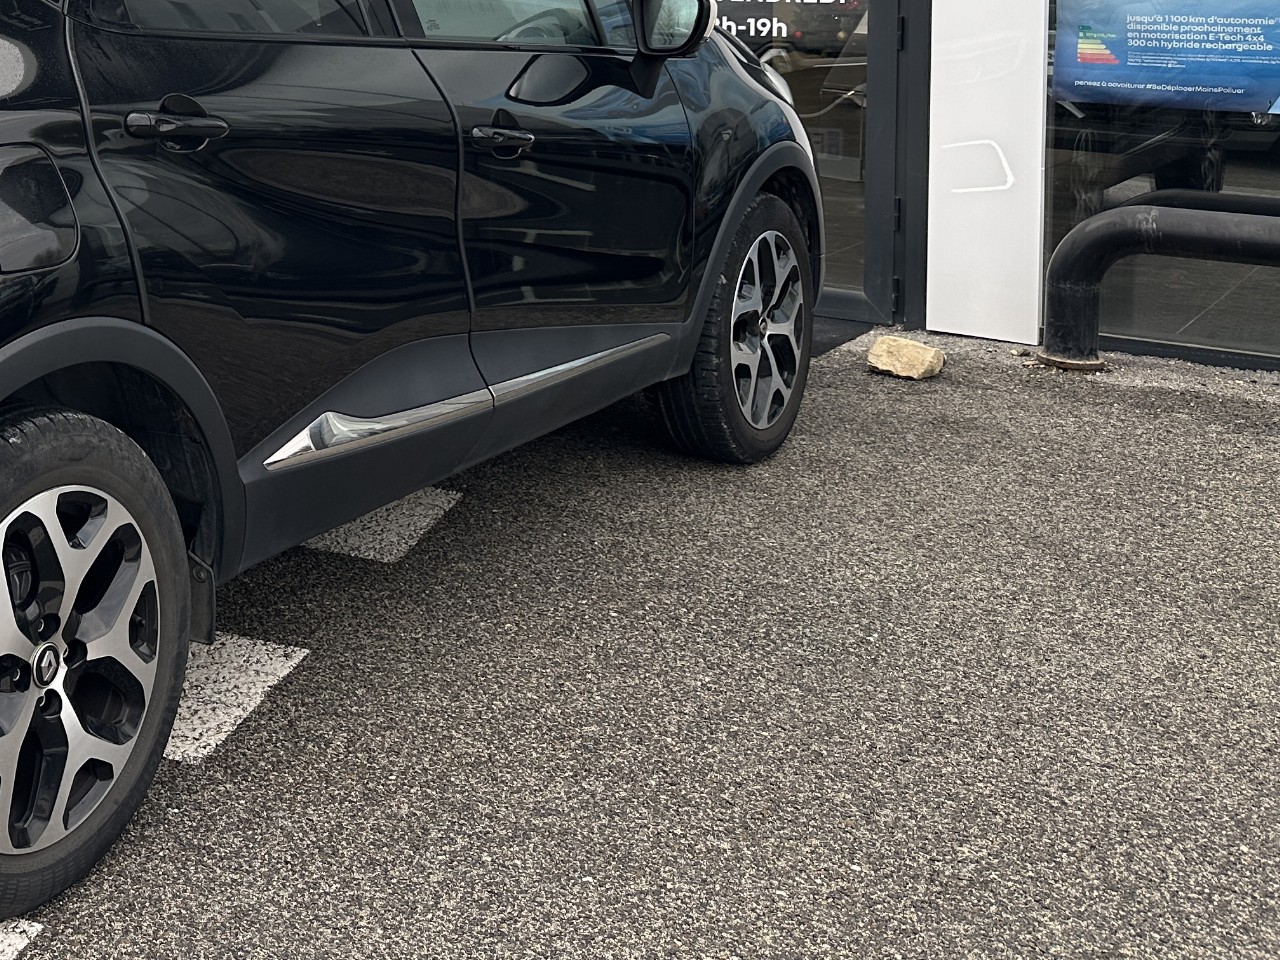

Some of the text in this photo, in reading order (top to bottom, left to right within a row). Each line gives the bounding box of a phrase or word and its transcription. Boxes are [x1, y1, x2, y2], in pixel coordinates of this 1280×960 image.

[1189, 15, 1206, 24] km
[716, 16, 788, 38] h-19h
[1126, 22, 1262, 34] disponible prochainement
[1140, 31, 1208, 41] motorisation
[1208, 33, 1244, 42] E-Tech
[1245, 34, 1265, 42] 4x4
[1126, 39, 1146, 47] 300
[1160, 40, 1200, 50] hybride
[1201, 42, 1273, 52] rechargeable
